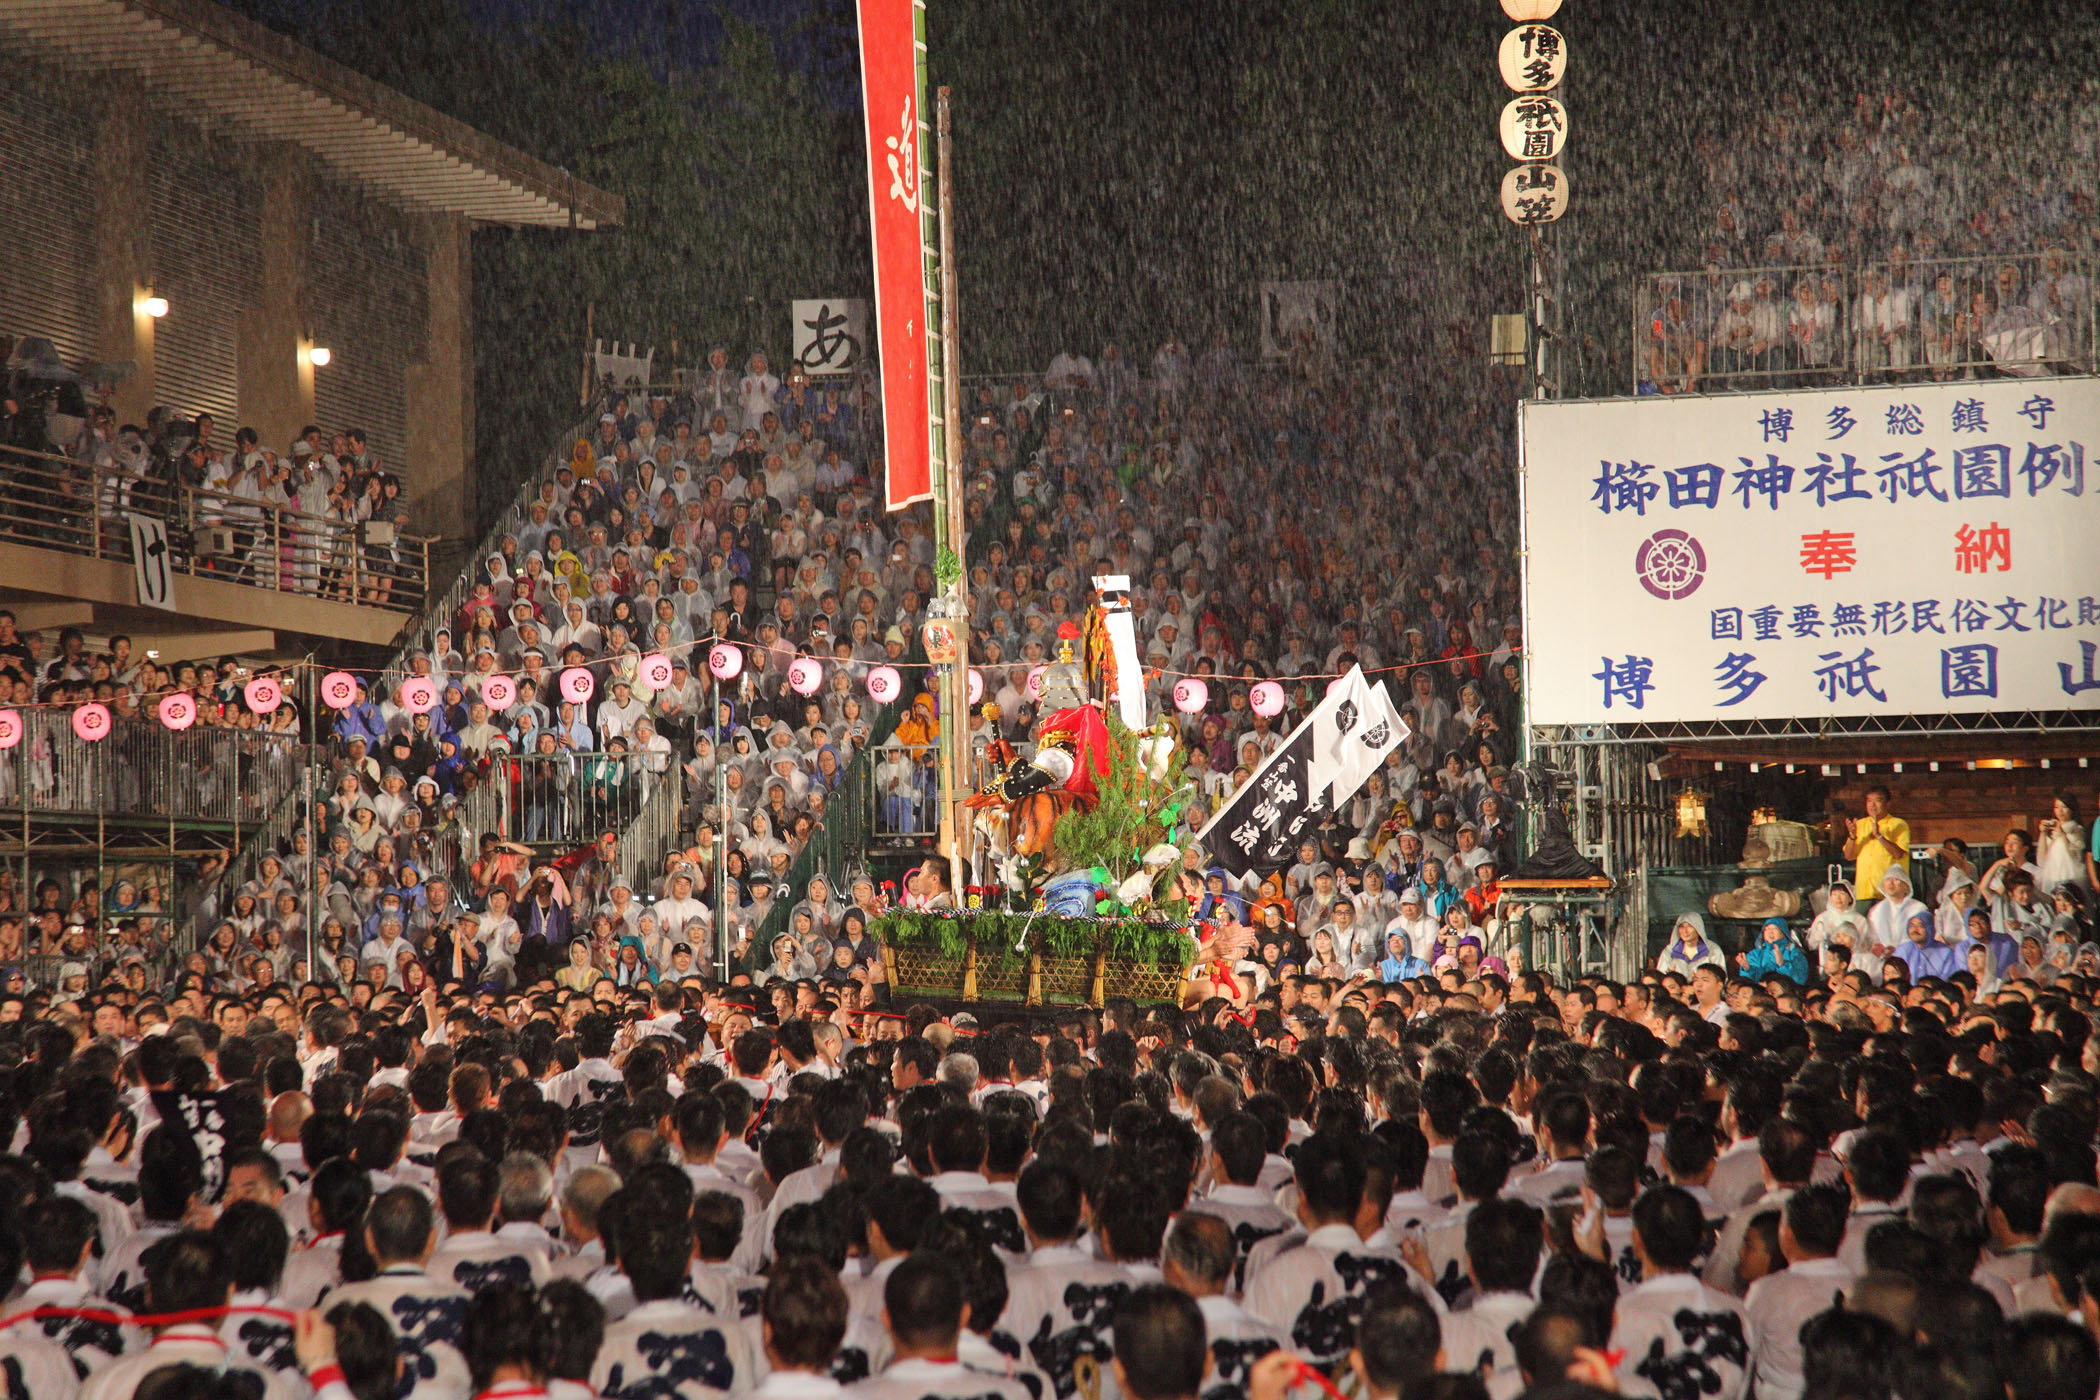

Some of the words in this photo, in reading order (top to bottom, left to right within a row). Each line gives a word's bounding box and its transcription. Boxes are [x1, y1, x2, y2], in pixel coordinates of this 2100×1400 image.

[802, 304, 861, 369] あ
[1757, 395, 2055, 443] 博多総鎮守
[1590, 441, 2100, 516] 櫛田神社祇園例
[138, 524, 167, 603] け
[1800, 521, 2011, 580] 奉納
[1230, 779, 1298, 856] 中洲流
